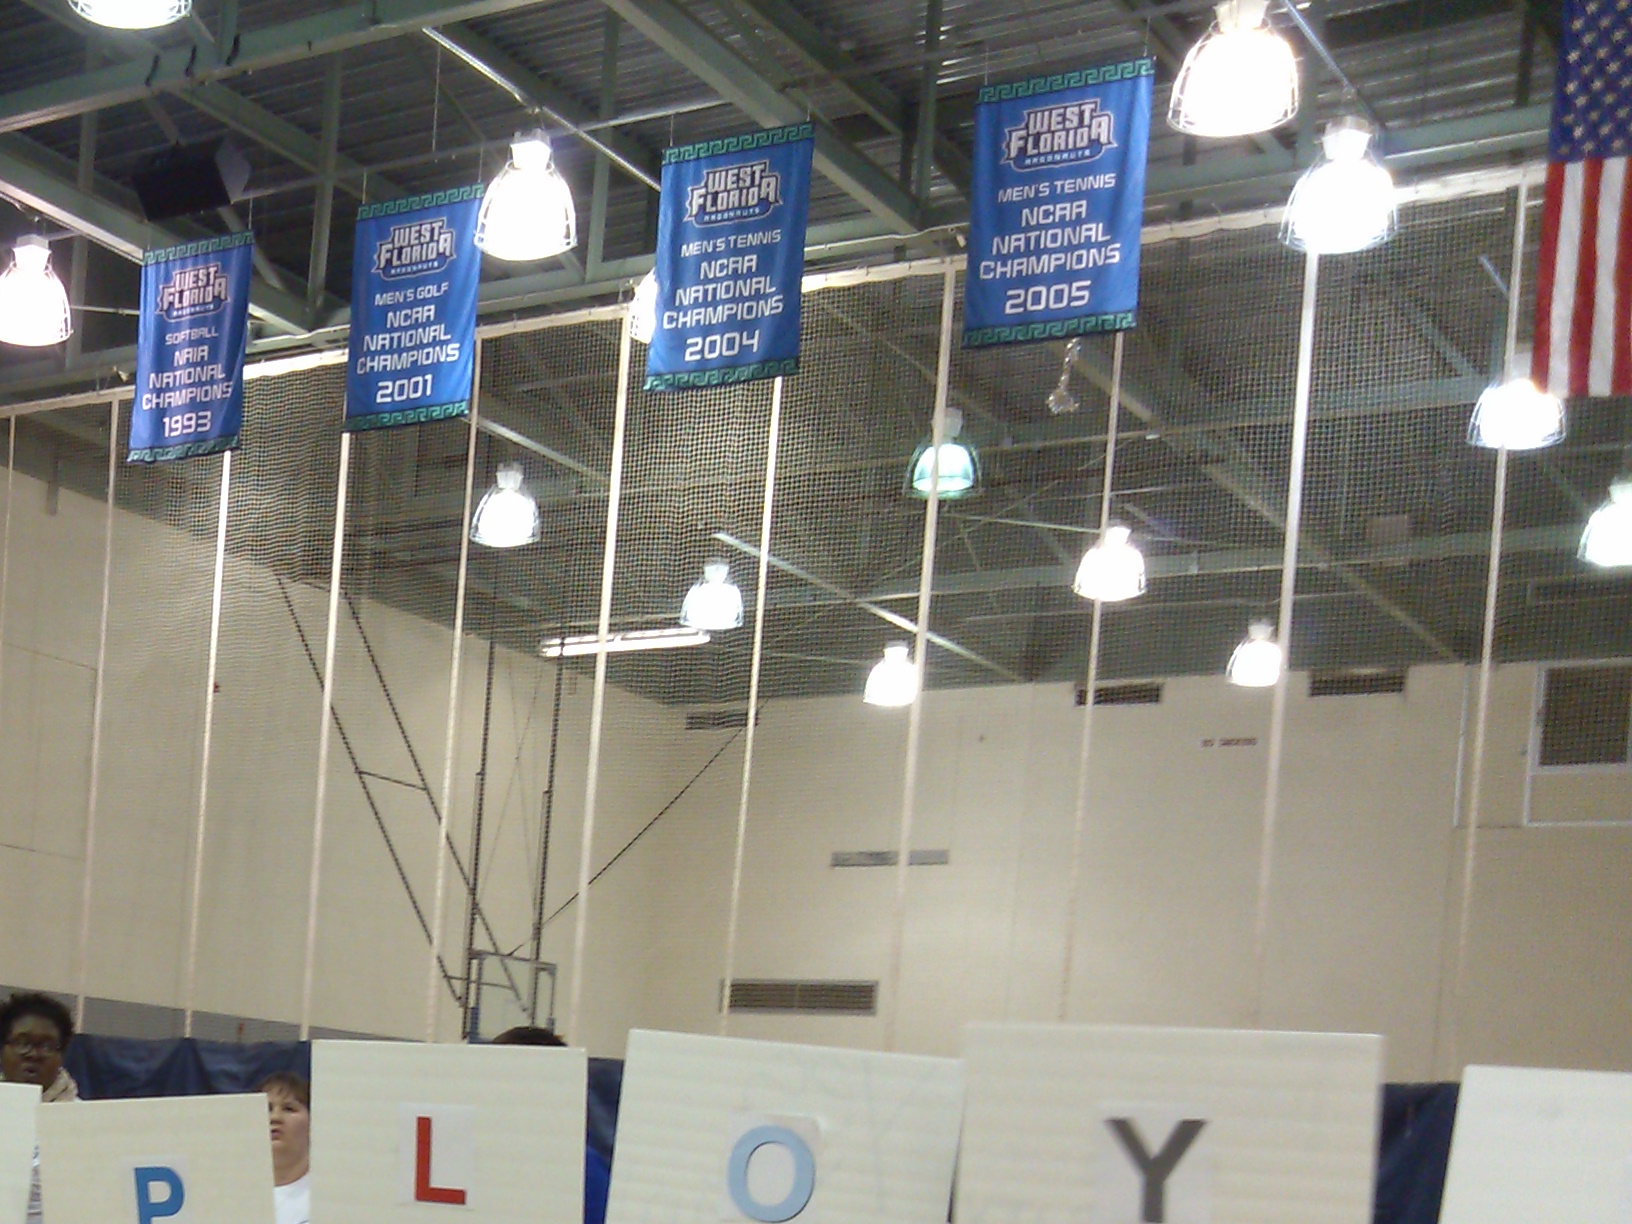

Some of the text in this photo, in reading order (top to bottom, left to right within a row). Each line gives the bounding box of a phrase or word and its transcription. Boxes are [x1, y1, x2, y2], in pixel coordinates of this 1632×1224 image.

[1029, 103, 1096, 135] WEST
[1009, 115, 1108, 158] FLORIDA
[708, 166, 764, 193] WEST
[998, 173, 1116, 203] MEN'S TENNIS
[692, 176, 775, 214] FLORIDA
[1021, 200, 1088, 227] NCAA
[394, 222, 444, 245] WEST
[681, 229, 781, 258] MEN'S TENNIS
[992, 222, 1111, 255] NATIONAL
[380, 232, 451, 268] FLORIDA
[979, 243, 1121, 280] CHAMPIONS
[176, 267, 217, 291] WEST
[700, 254, 757, 279] NCAA
[163, 277, 227, 309] FLORIDA
[375, 282, 449, 305] MEN'S GOLF
[675, 276, 776, 306] NATIONAL
[1004, 280, 1092, 315] 2005
[387, 305, 435, 328] NCAA
[663, 295, 783, 330] CHAMPIONS
[165, 326, 218, 345] SOFTBALL
[364, 325, 451, 351] NATIONAL
[685, 329, 759, 362] 2004
[174, 346, 209, 367] NAIA
[357, 344, 460, 375] CHAMPIONS
[149, 364, 225, 389] NATIONAL
[377, 374, 433, 403] 2001
[142, 382, 232, 410] CHAMPIONS
[163, 411, 211, 437] 1993
[415, 1115, 467, 1206] L
[726, 1124, 817, 1224] O
[1104, 1118, 1209, 1224] Y
